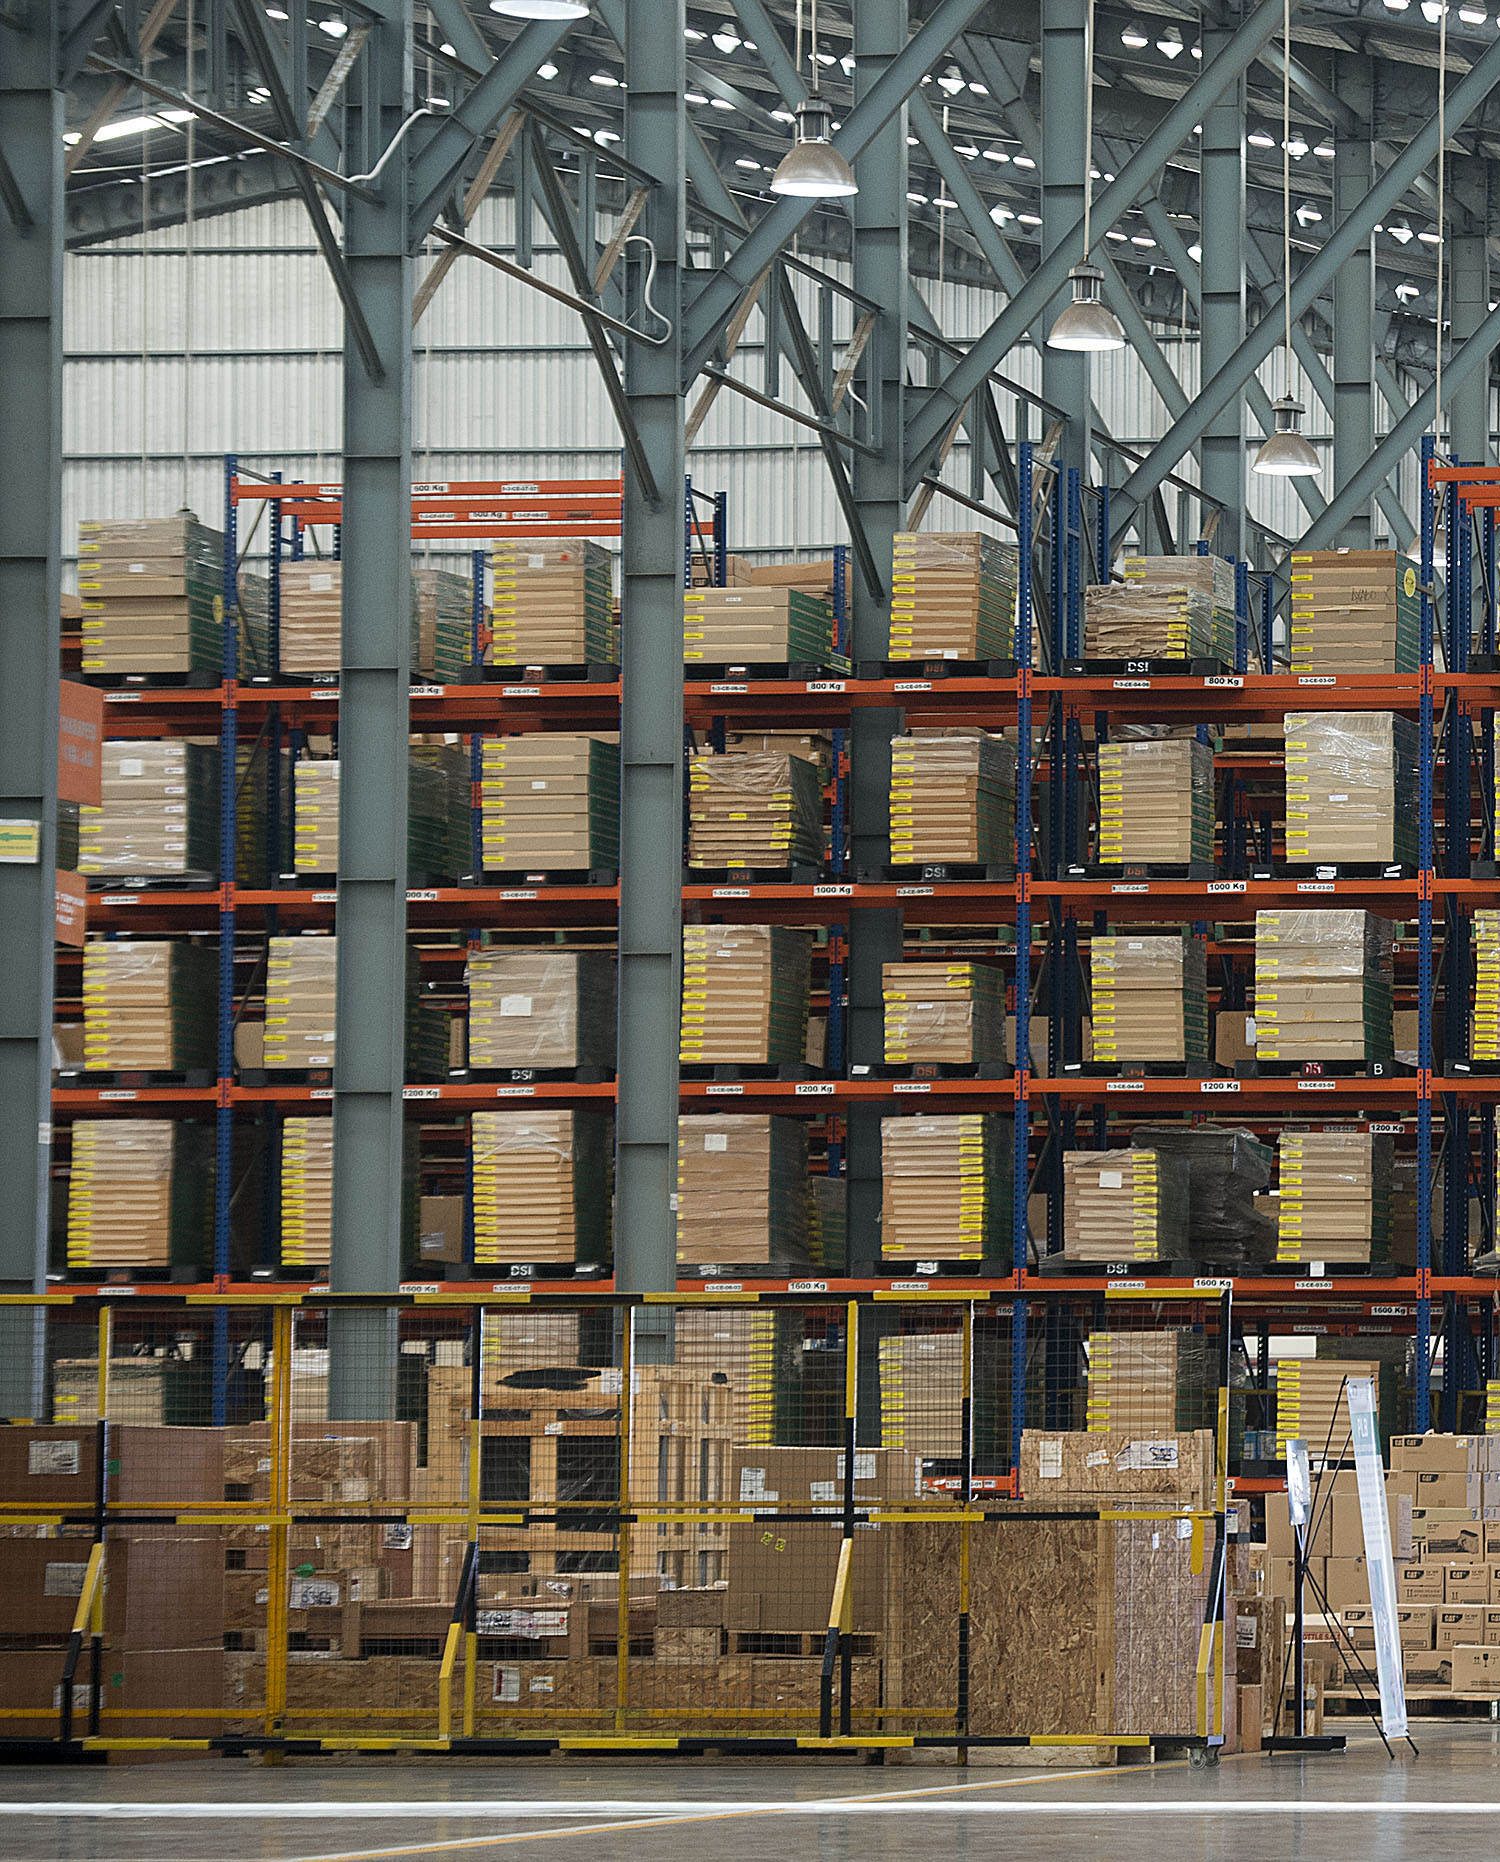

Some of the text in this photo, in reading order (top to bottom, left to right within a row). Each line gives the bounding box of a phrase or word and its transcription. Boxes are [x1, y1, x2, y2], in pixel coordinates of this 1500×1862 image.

[432, 484, 444, 494] Kg
[1127, 661, 1149, 673] DSI
[811, 682, 841, 692] 800 Kg
[1208, 677, 1239, 688] 800 Kg
[428, 687, 440, 696] Kg
[816, 886, 851, 896] 1000 Kg
[1209, 881, 1245, 892] 1000 Kg
[406, 890, 437, 900] 000 Kg
[1373, 1063, 1383, 1076] B
[511, 1070, 533, 1081] DSI
[798, 1085, 833, 1096] 1200 Kg
[1203, 1082, 1239, 1092] 1200 Kg
[404, 1089, 438, 1099] 1200 Kg
[1393, 1125, 1404, 1133] Kg
[510, 1265, 532, 1276] DSI
[1107, 1263, 1128, 1277] DSI
[791, 1282, 826, 1292] 1600 Kg
[1195, 1279, 1232, 1289] 1600 Kg
[424, 1285, 437, 1294] Kg
[1394, 1307, 1406, 1315] Kg
[1302, 1632, 1323, 1641] OTTLE
